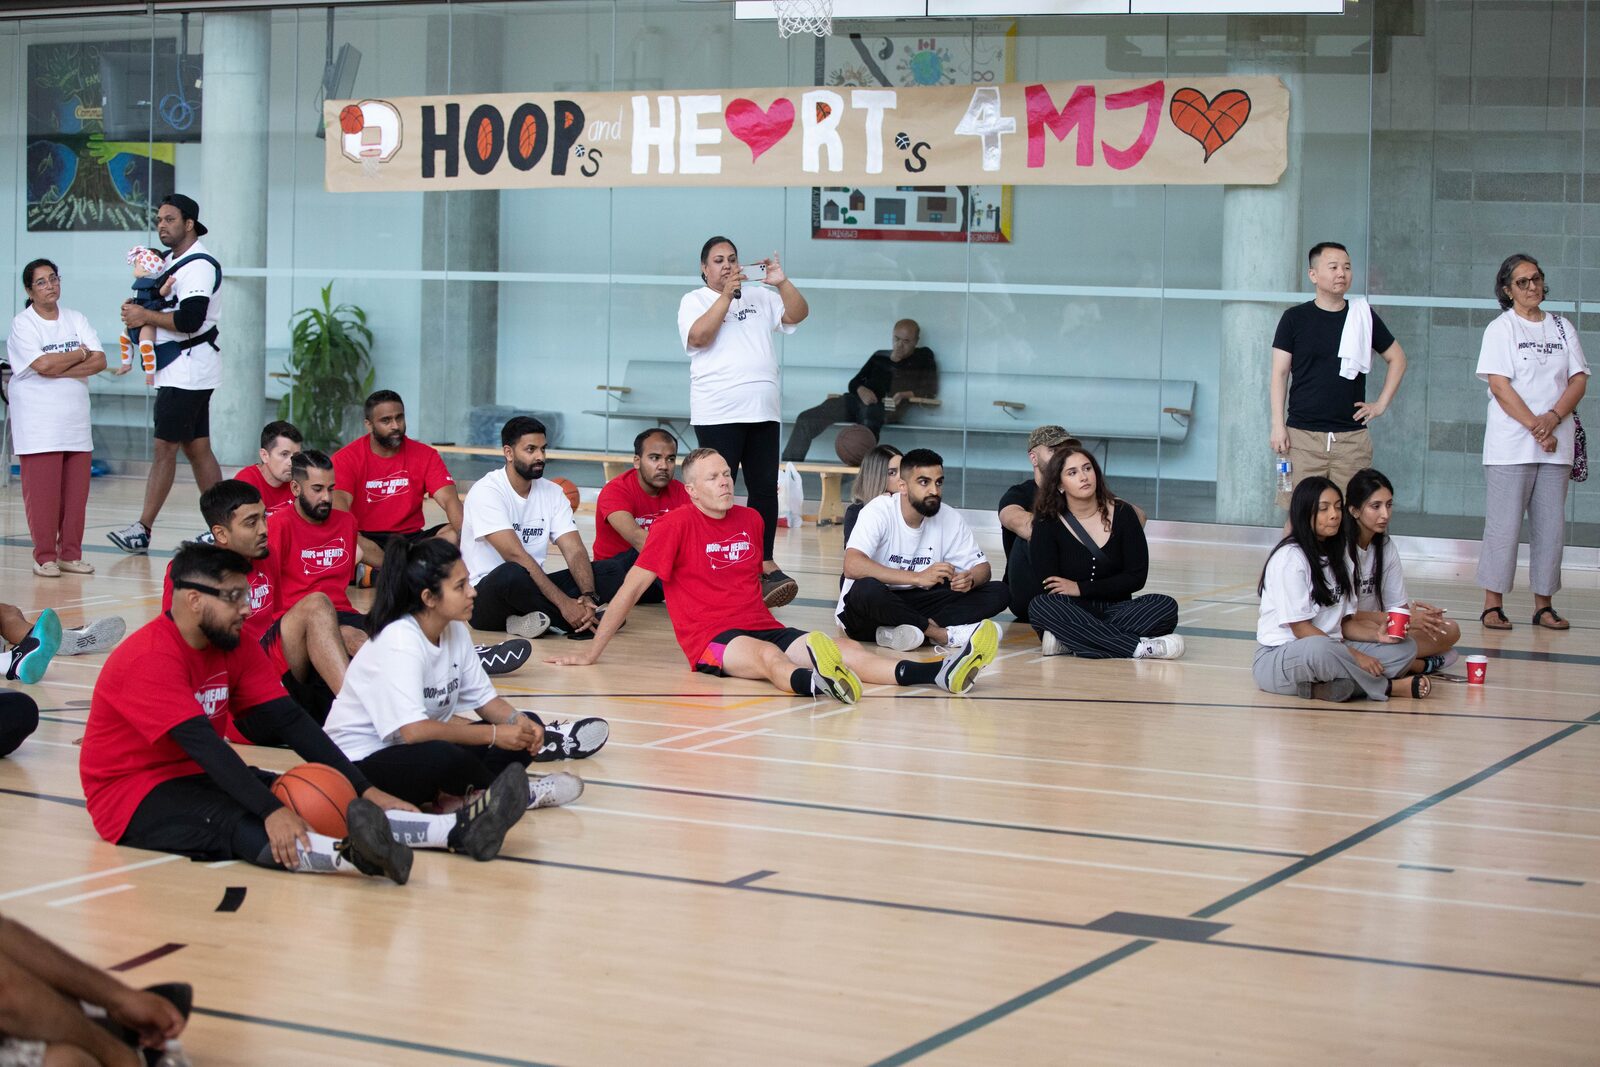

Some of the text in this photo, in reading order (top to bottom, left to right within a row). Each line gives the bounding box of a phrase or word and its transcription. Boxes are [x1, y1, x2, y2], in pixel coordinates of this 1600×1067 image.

[587, 105, 621, 142] and
[954, 87, 1016, 171] 4
[1025, 79, 1165, 170] MJ
[365, 480, 383, 489] HOOPS
[389, 478, 409, 488] HEARTS
[387, 486, 396, 495] MJ
[522, 527, 544, 537] HEARTS
[324, 547, 343, 558] HEARTS
[706, 543, 721, 553] HOOP
[730, 541, 750, 552] HEARTS
[323, 557, 333, 566] MJ
[729, 551, 740, 561] MJ
[205, 687, 228, 702] HEAR
